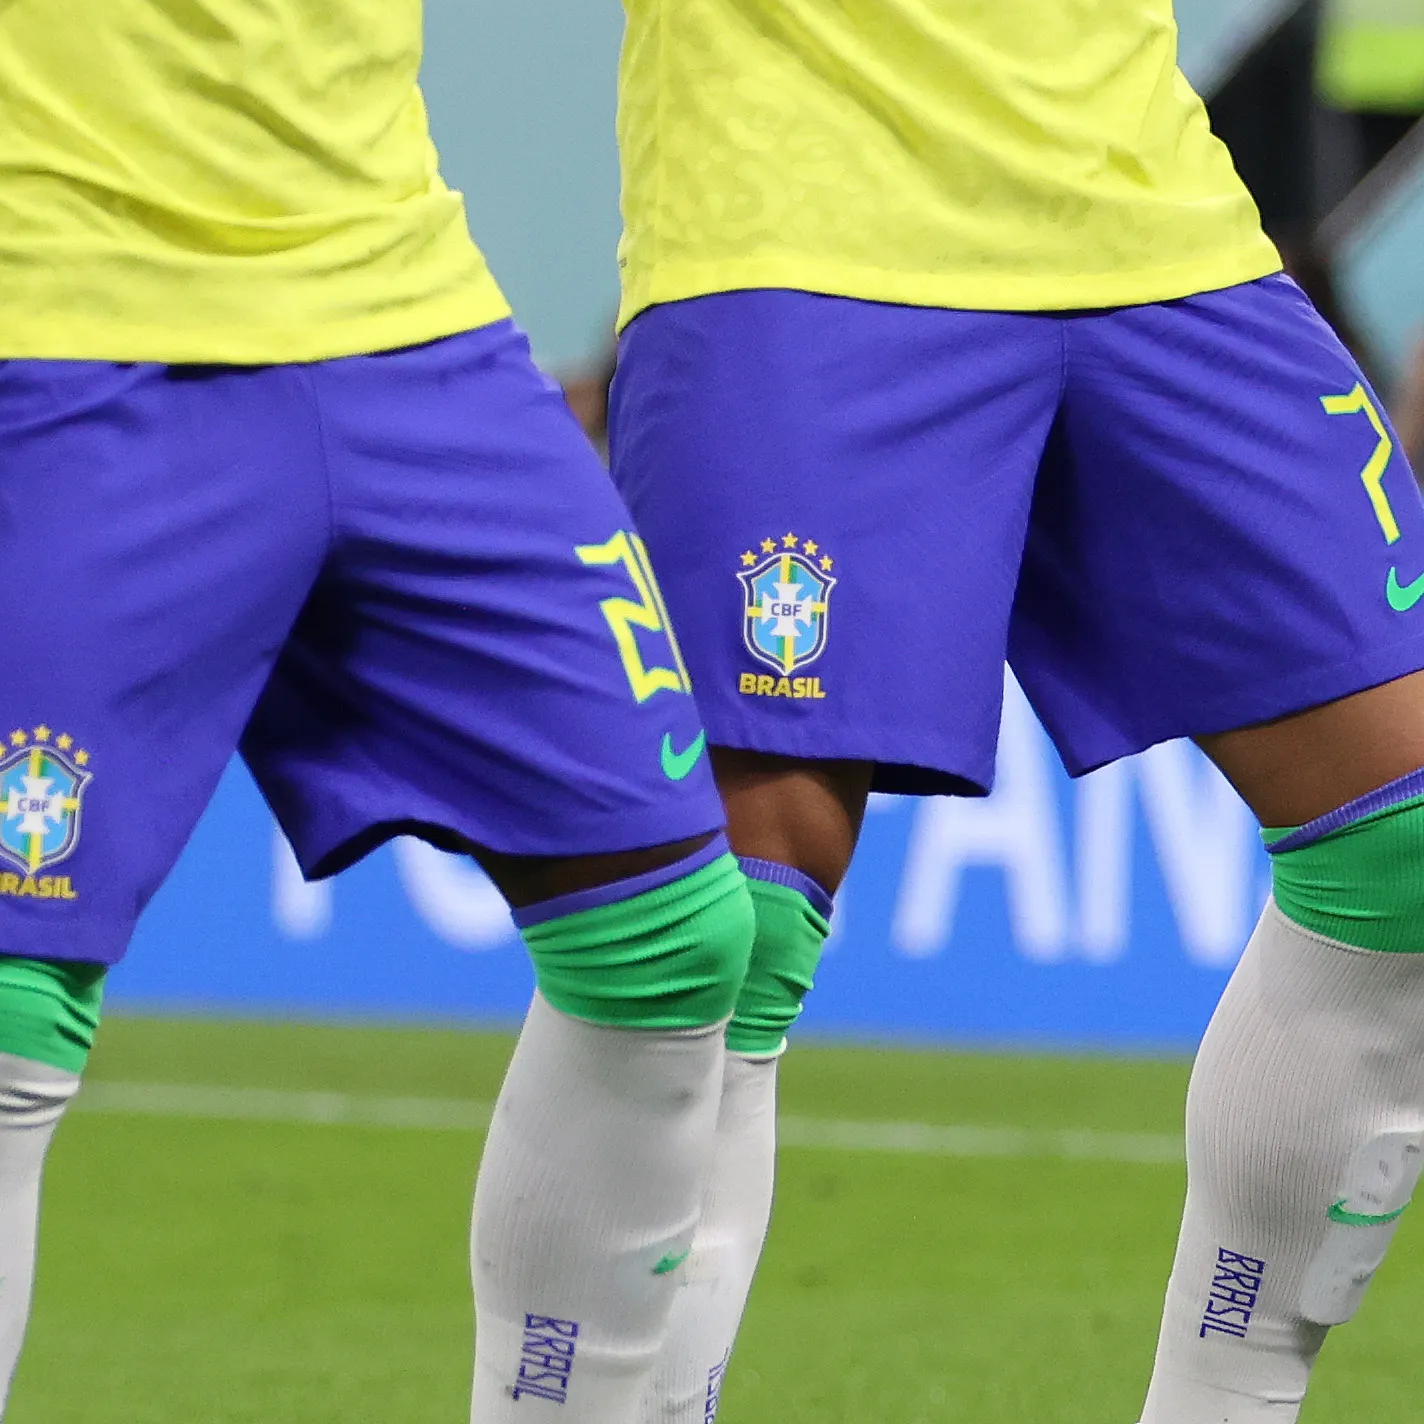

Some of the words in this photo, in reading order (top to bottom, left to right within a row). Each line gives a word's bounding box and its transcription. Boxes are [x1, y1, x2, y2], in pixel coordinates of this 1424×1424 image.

[1320, 380, 1401, 545] 7
[770, 602, 803, 617] CBF
[738, 672, 827, 699] BRASIL
[1199, 1246, 1266, 1338] BRASIL
[512, 1311, 581, 1405] BRASIL
